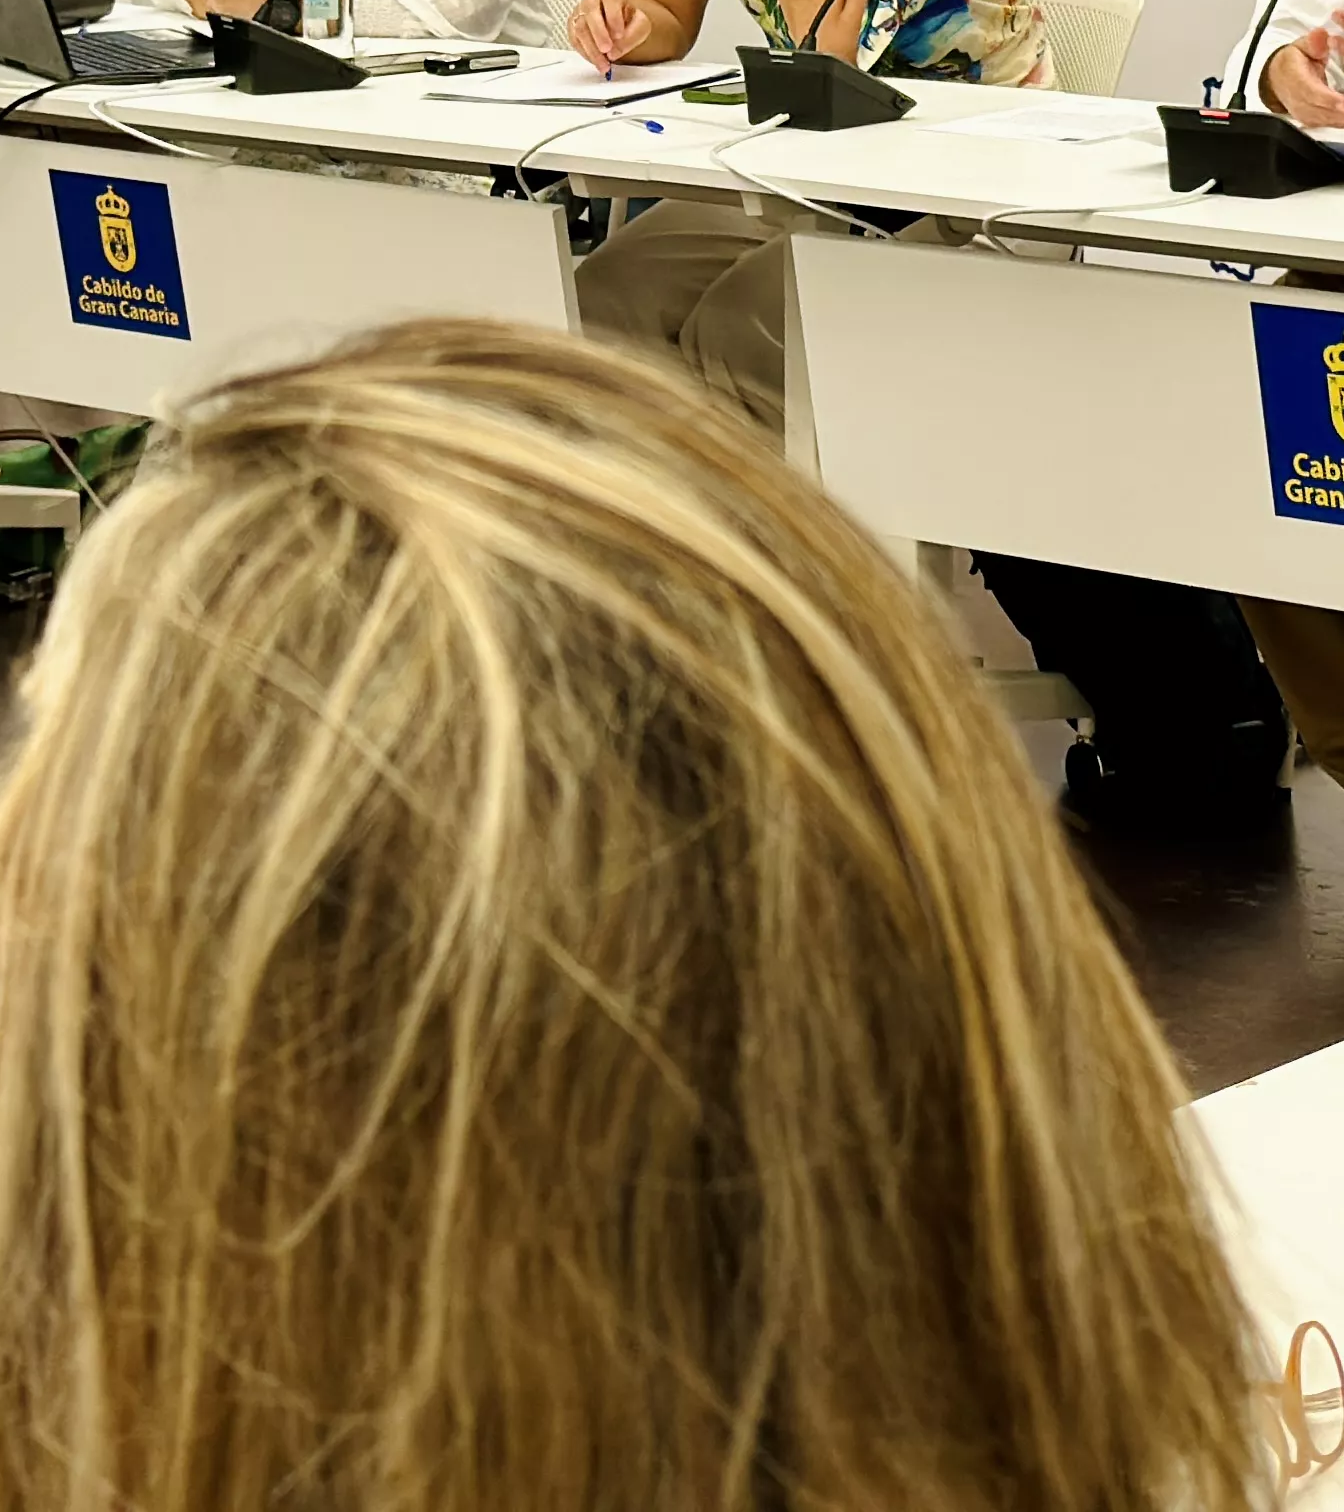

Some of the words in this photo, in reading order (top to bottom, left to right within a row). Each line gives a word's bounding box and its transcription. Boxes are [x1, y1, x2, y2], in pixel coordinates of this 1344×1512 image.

[82, 275, 143, 301] Cabildo
[145, 286, 165, 305] de
[79, 294, 117, 316] Gran
[118, 300, 180, 326] Canaria
